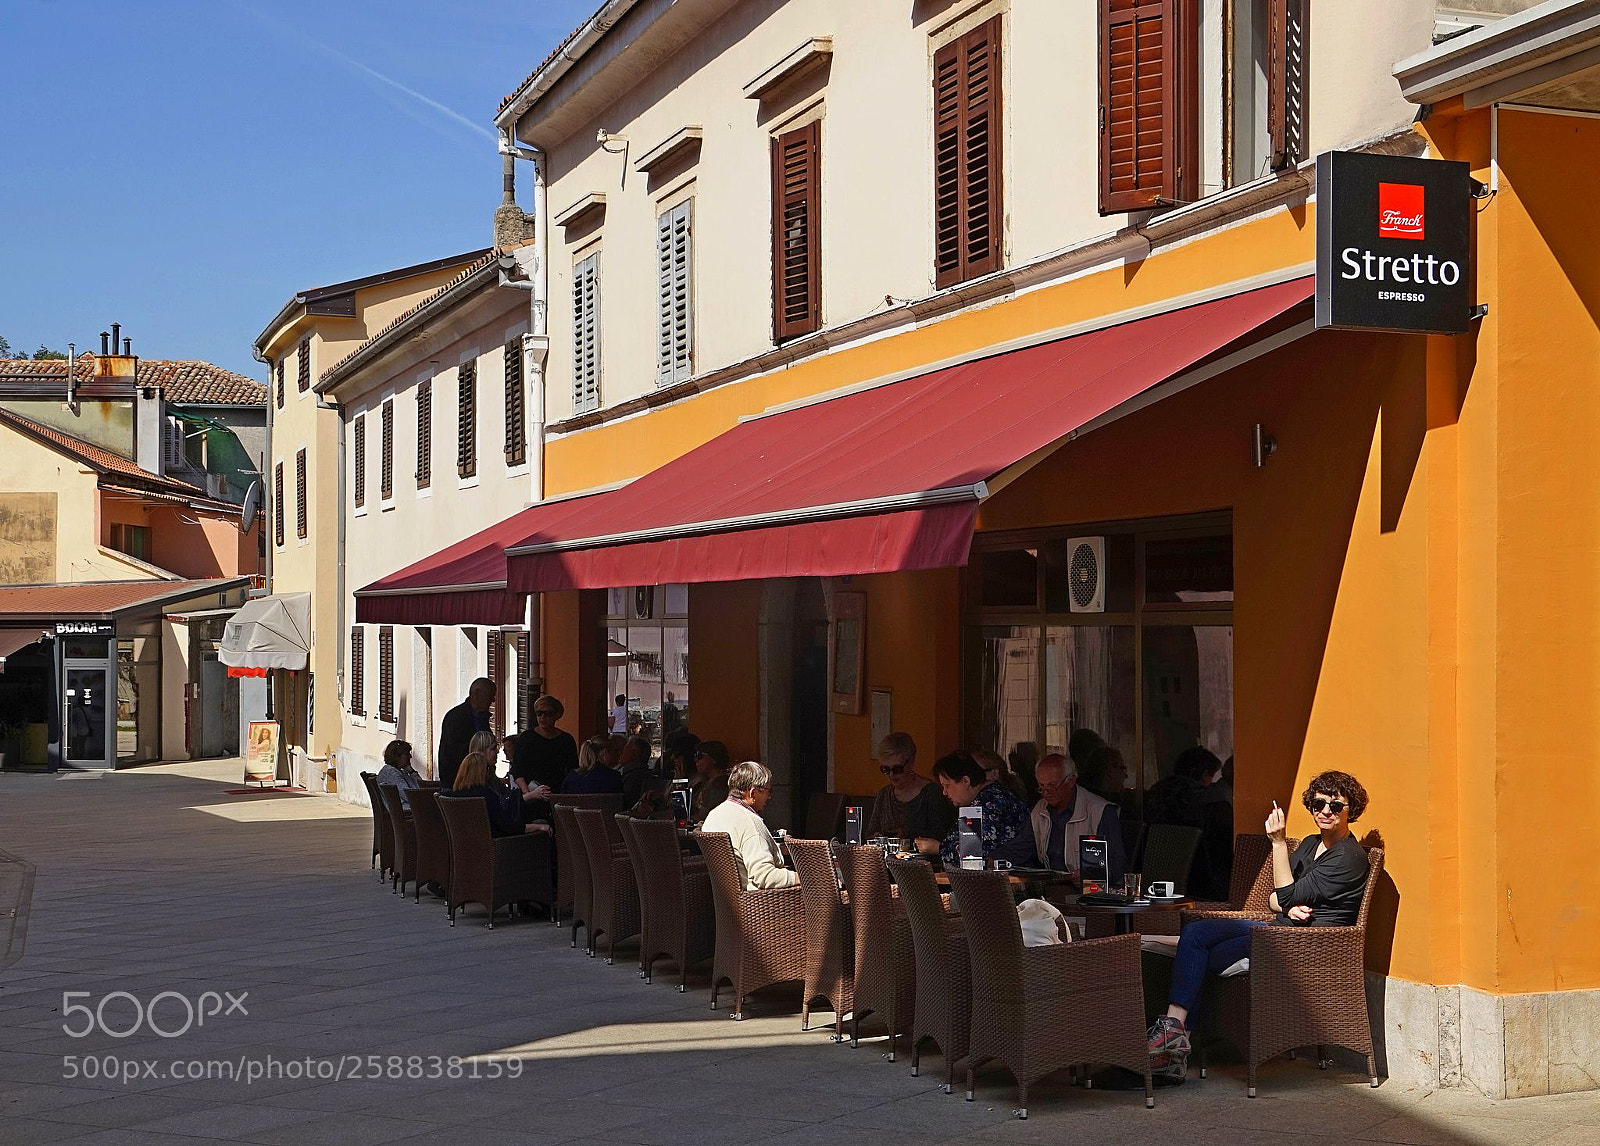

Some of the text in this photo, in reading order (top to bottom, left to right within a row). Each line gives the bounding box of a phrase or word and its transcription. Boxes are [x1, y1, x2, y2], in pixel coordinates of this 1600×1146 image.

[1381, 210, 1423, 229] Franck
[1341, 247, 1460, 286] Stretto
[1378, 291, 1425, 302] ESPRESSO
[56, 622, 97, 634] BOOM
